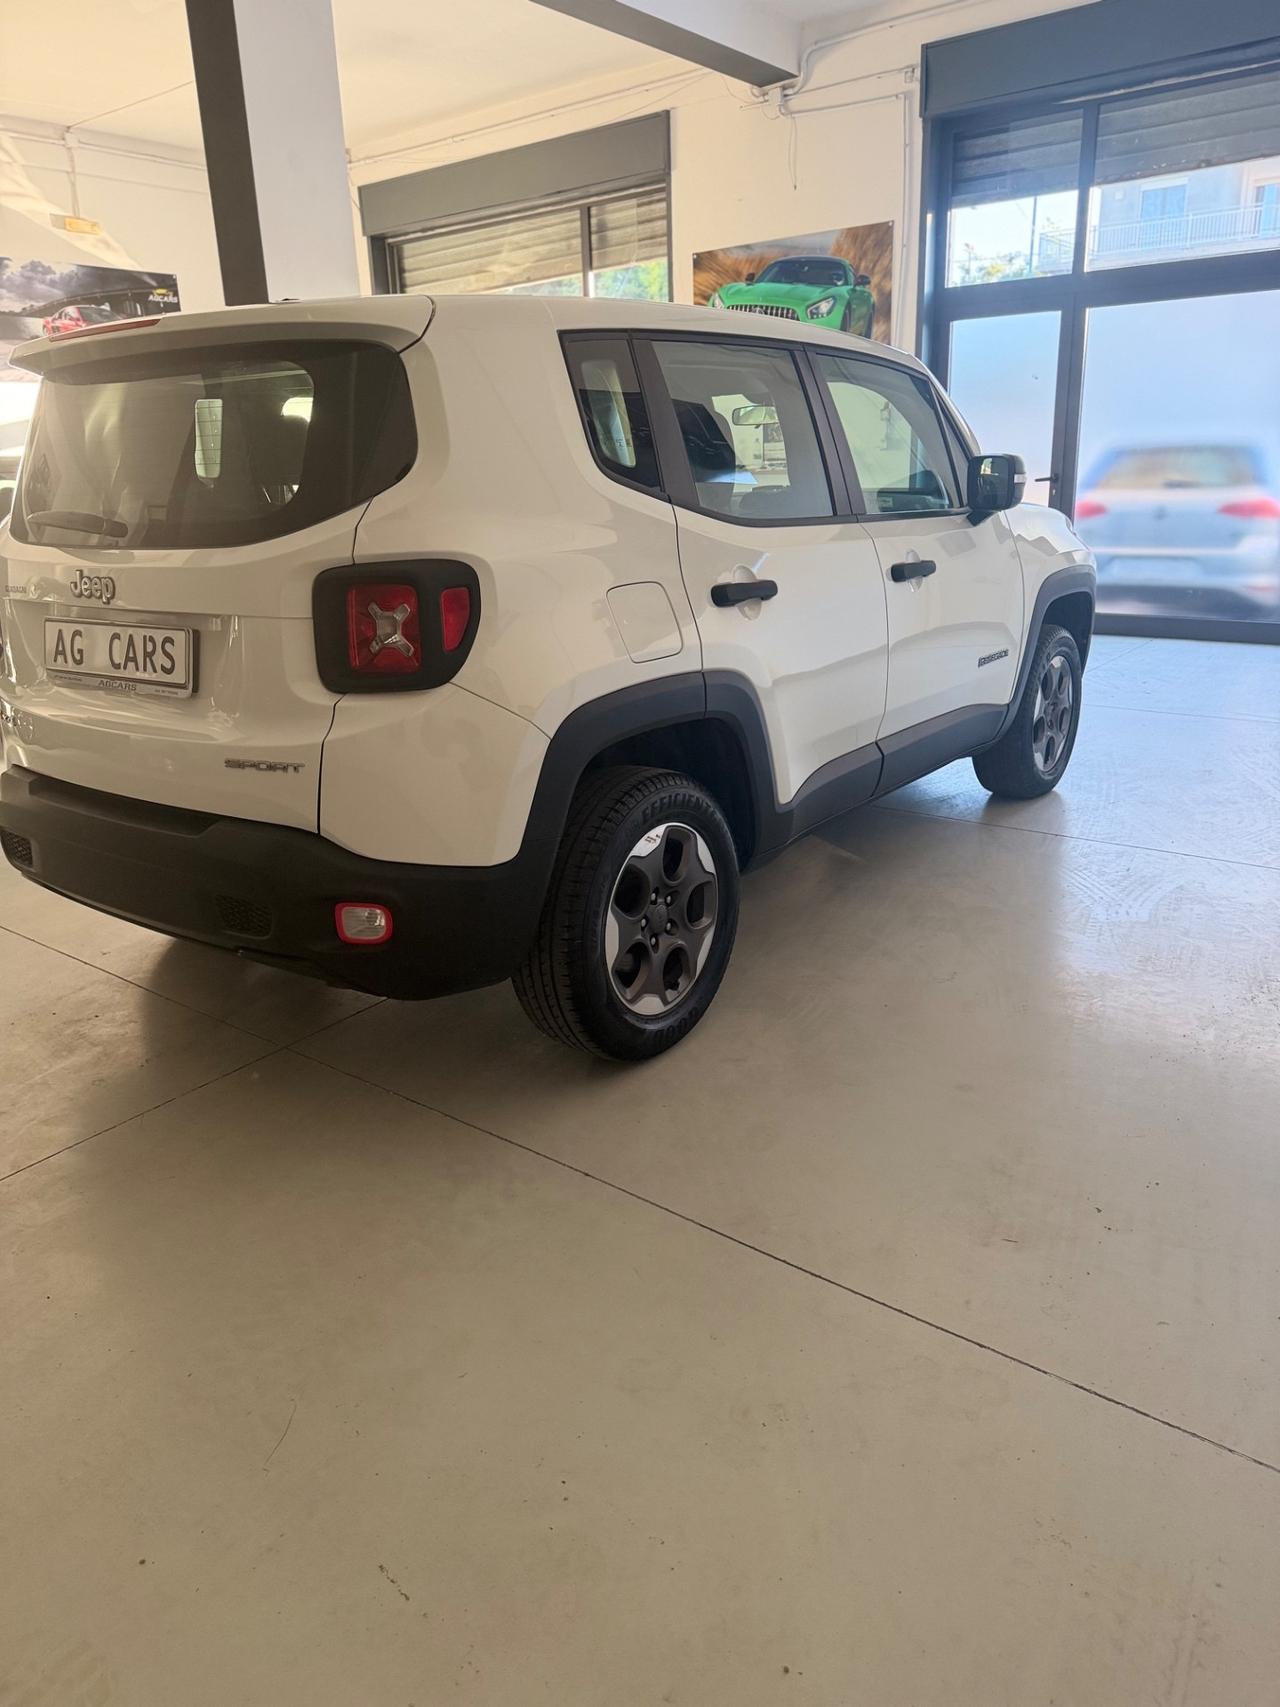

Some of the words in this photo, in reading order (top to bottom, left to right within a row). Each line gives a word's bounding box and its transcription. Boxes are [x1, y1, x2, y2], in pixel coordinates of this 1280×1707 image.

[70, 569, 115, 605] Jeep
[53, 629, 84, 665] AG
[108, 632, 176, 675] CARS
[224, 758, 305, 773] SPORT
